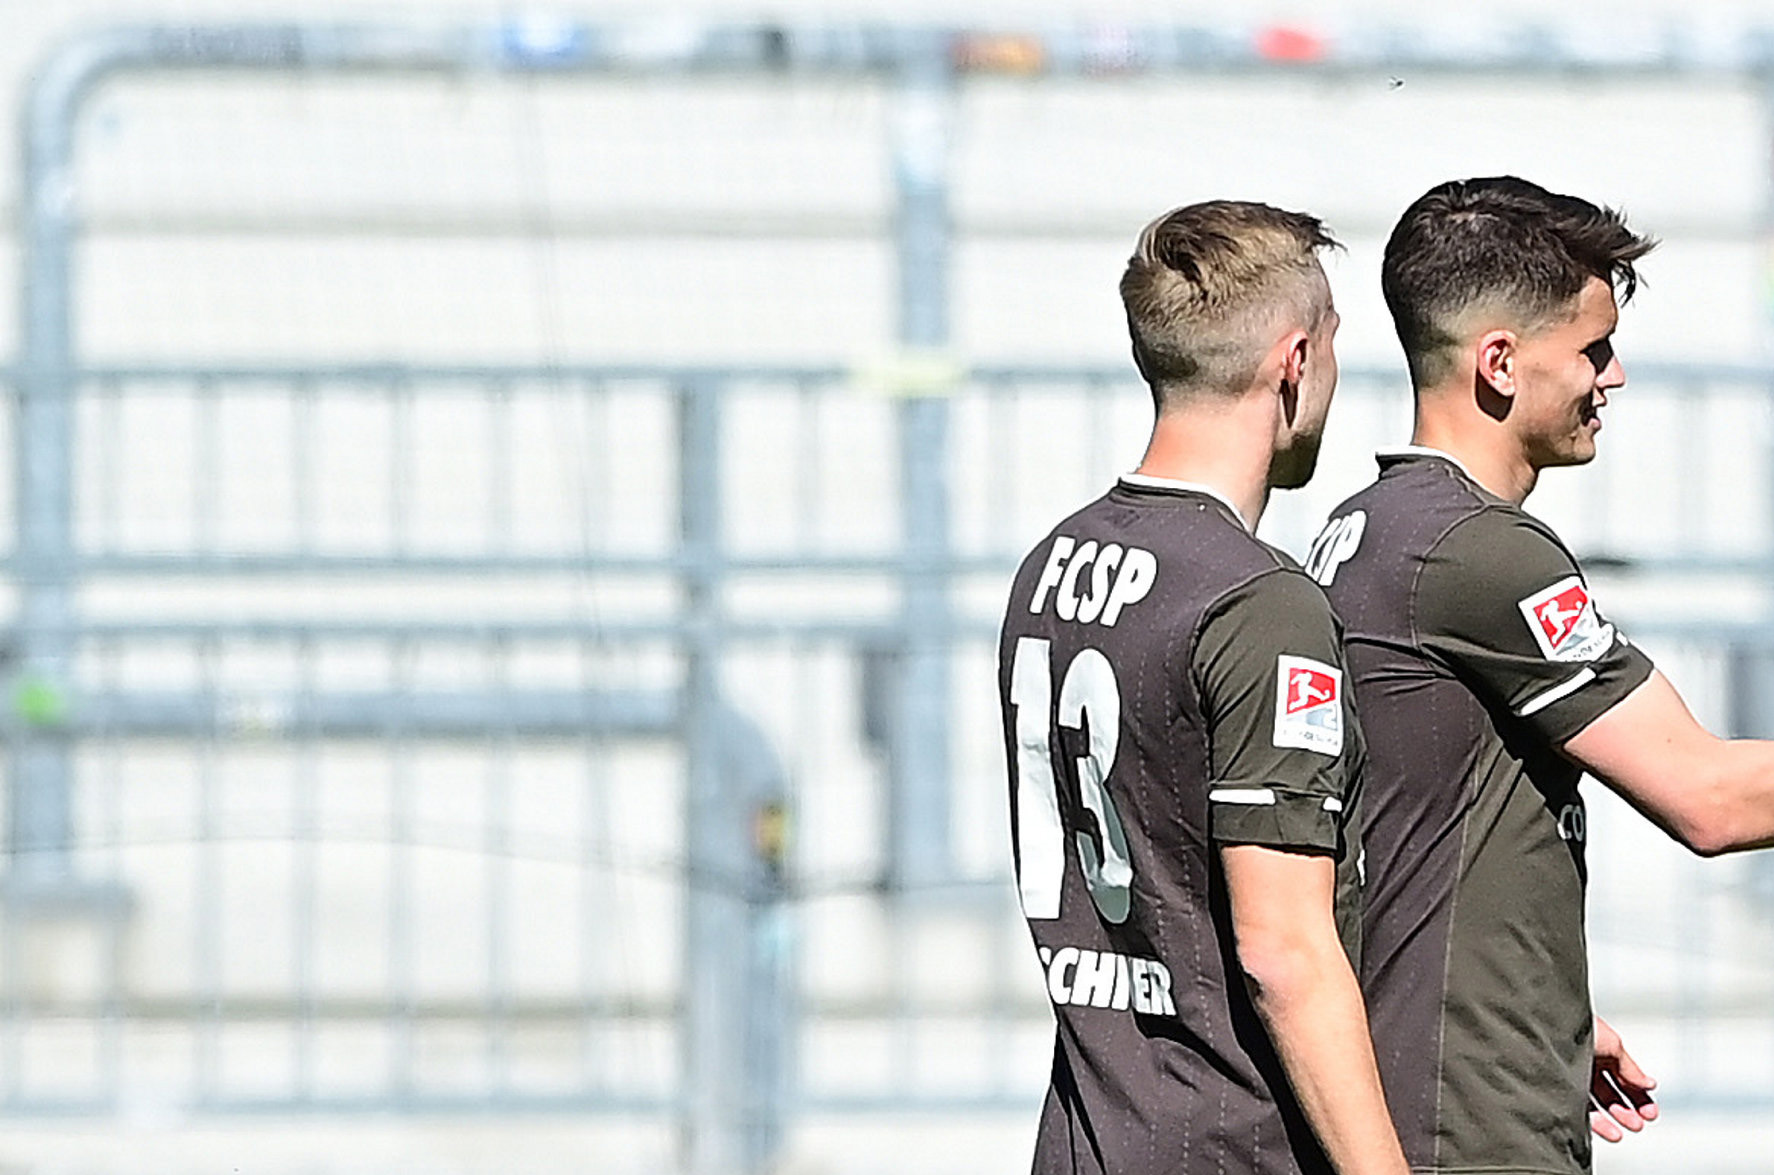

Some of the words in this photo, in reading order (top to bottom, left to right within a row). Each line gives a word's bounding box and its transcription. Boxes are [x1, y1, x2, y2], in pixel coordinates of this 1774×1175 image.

[1029, 535, 1158, 627] FCSP
[1010, 636, 1133, 925] 13
[1038, 946, 1178, 1016] CHIER
